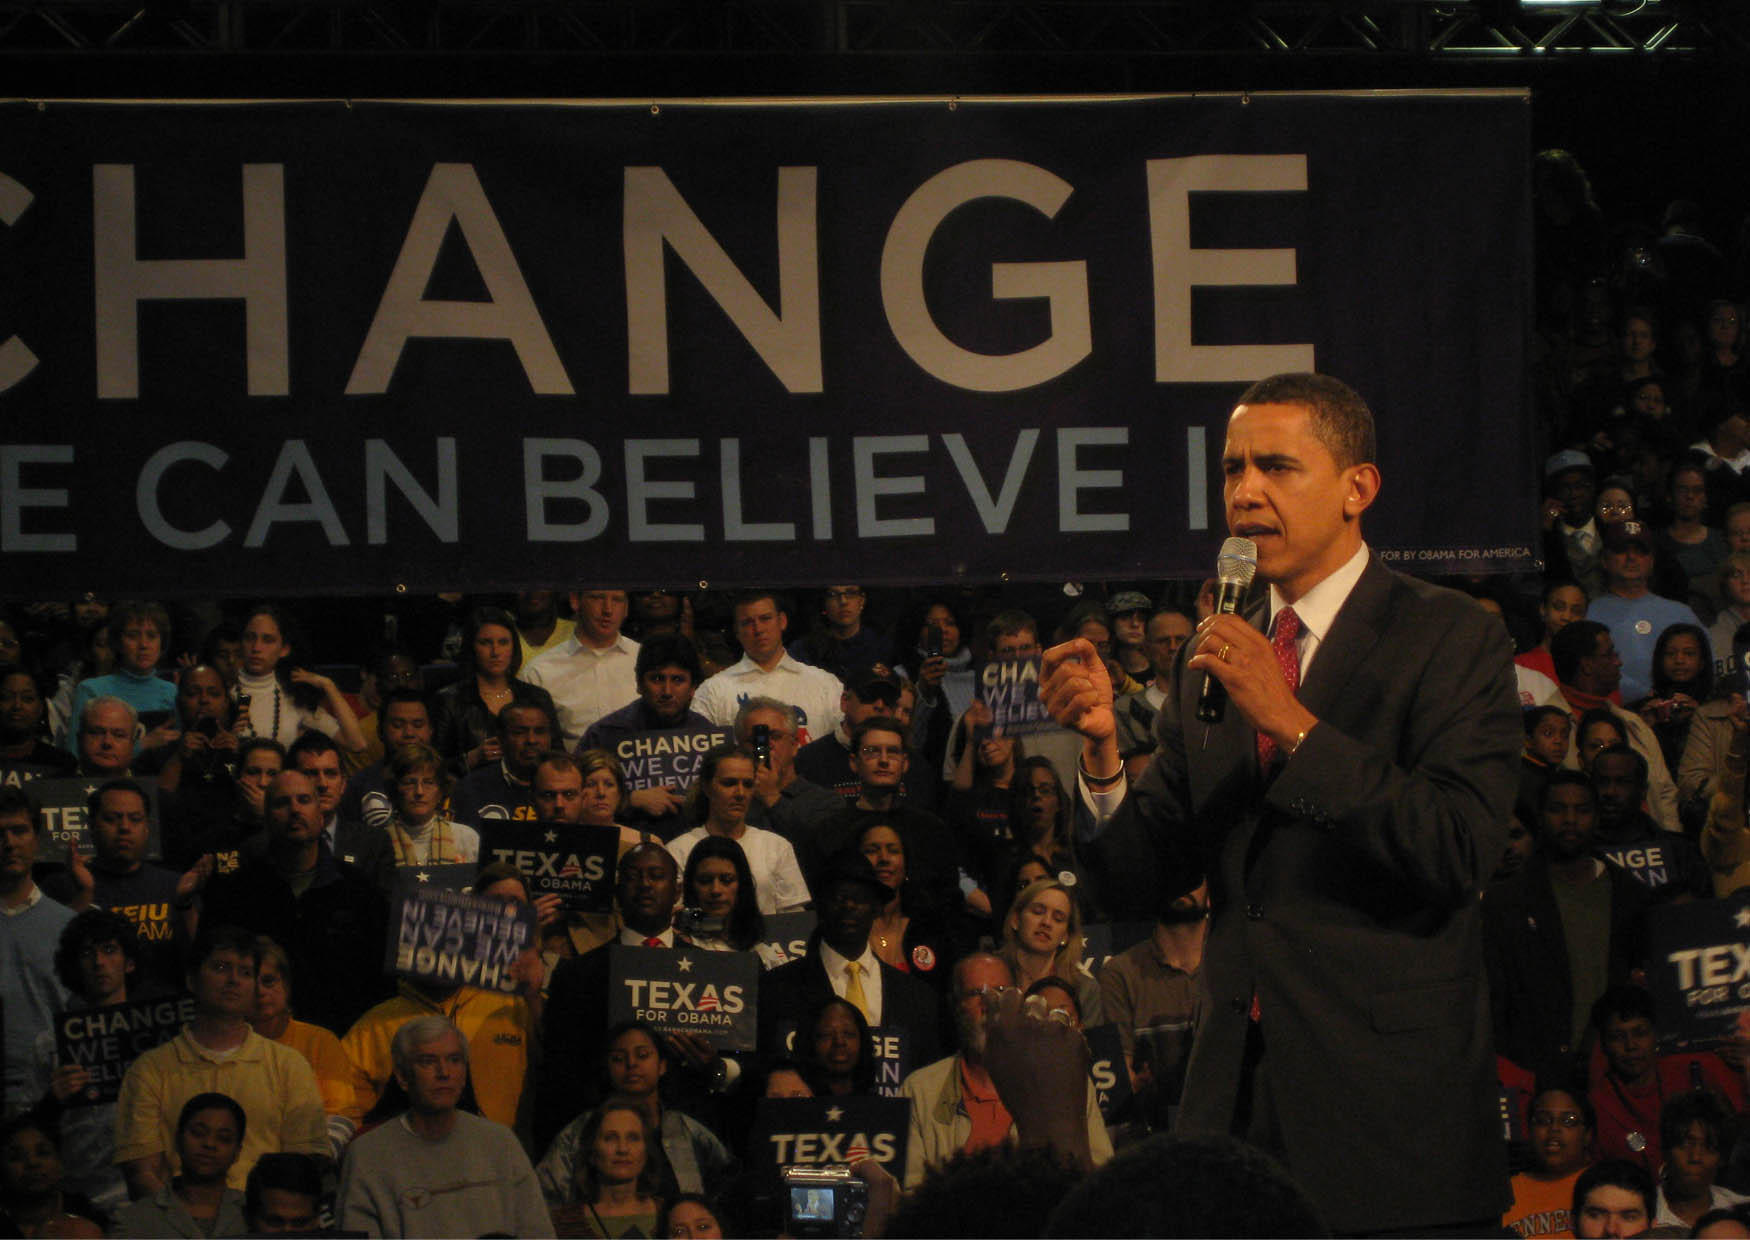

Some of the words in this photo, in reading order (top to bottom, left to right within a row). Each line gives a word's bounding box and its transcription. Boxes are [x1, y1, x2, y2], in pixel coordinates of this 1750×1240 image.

[0, 154, 1316, 399] HANGE
[0, 445, 77, 552] E
[136, 436, 461, 551] CAN
[524, 426, 1130, 544] BELIEVE
[1187, 426, 1208, 531] I
[1380, 551, 1399, 561] FOR
[1403, 551, 1416, 561] BY
[1418, 550, 1455, 560] OBAMA
[1458, 549, 1480, 559] FOR
[1482, 547, 1531, 558] AMERICA
[983, 661, 1038, 687] CHA
[616, 733, 726, 759] CHANGE
[620, 757, 664, 779] WE
[672, 753, 704, 774] CA
[491, 848, 606, 881] TEXAS
[540, 878, 593, 892] OBAMA
[396, 943, 517, 992] CHANGE
[624, 979, 745, 1014] TEXAS
[64, 997, 197, 1041] CHANGE
[636, 1009, 667, 1022] FOR
[677, 1012, 733, 1025] OBAMA
[66, 1037, 121, 1064] WE
[768, 1132, 897, 1165] TEXAS
